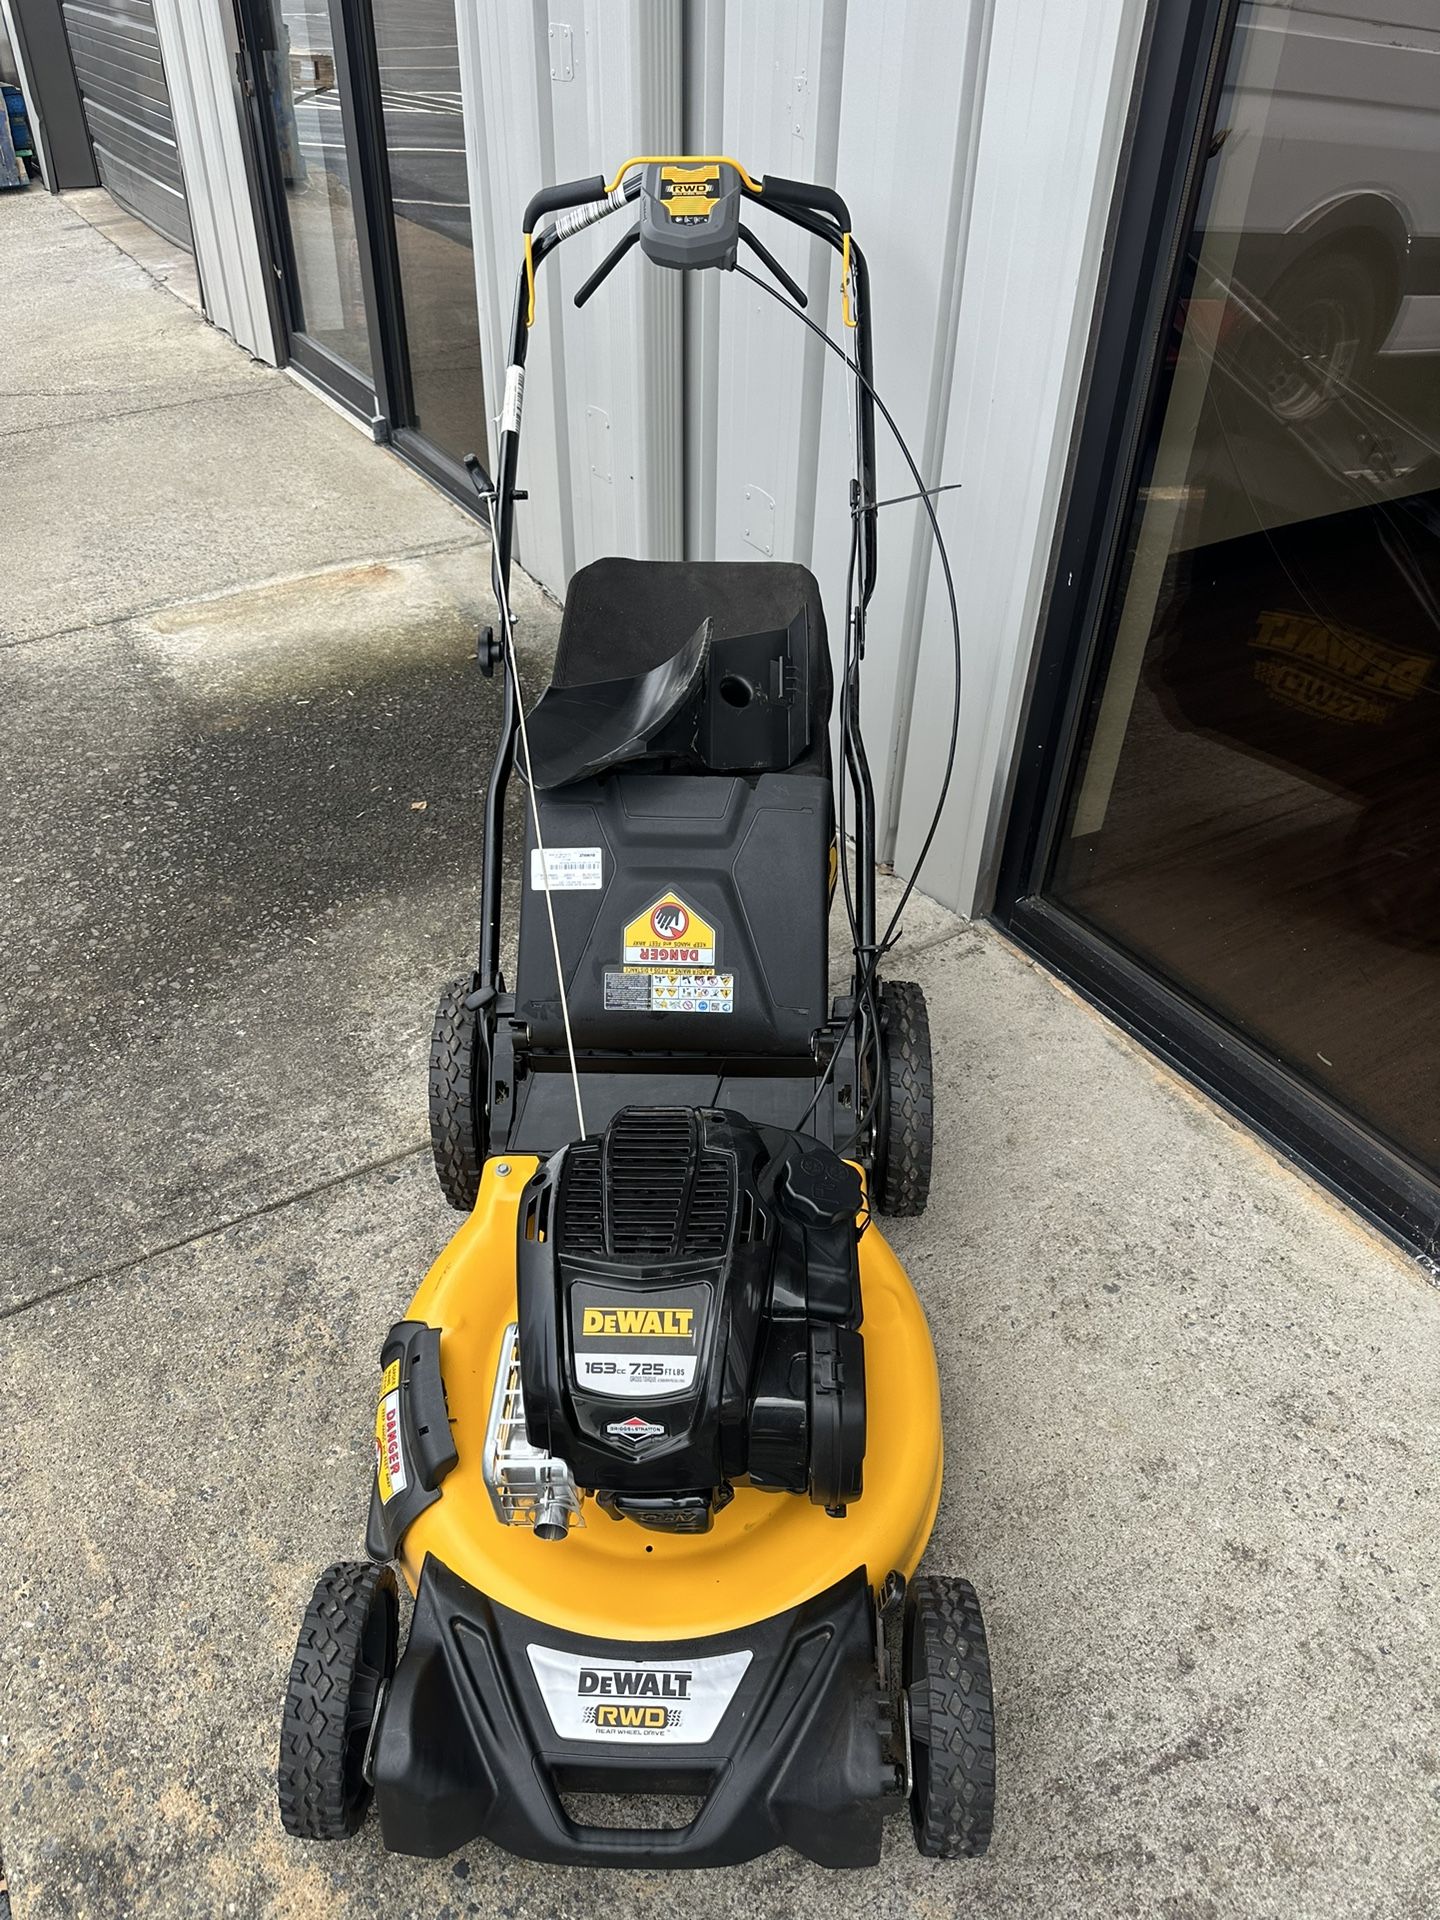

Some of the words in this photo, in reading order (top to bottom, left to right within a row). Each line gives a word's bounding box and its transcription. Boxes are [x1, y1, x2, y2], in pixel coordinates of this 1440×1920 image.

[639, 948, 699, 962] DANGER
[629, 1363, 664, 1375] 7.25
[665, 1368, 672, 1376] FT
[673, 1368, 685, 1376] LBS
[386, 1408, 400, 1476] DANGER
[597, 1706, 665, 1727] RWD
